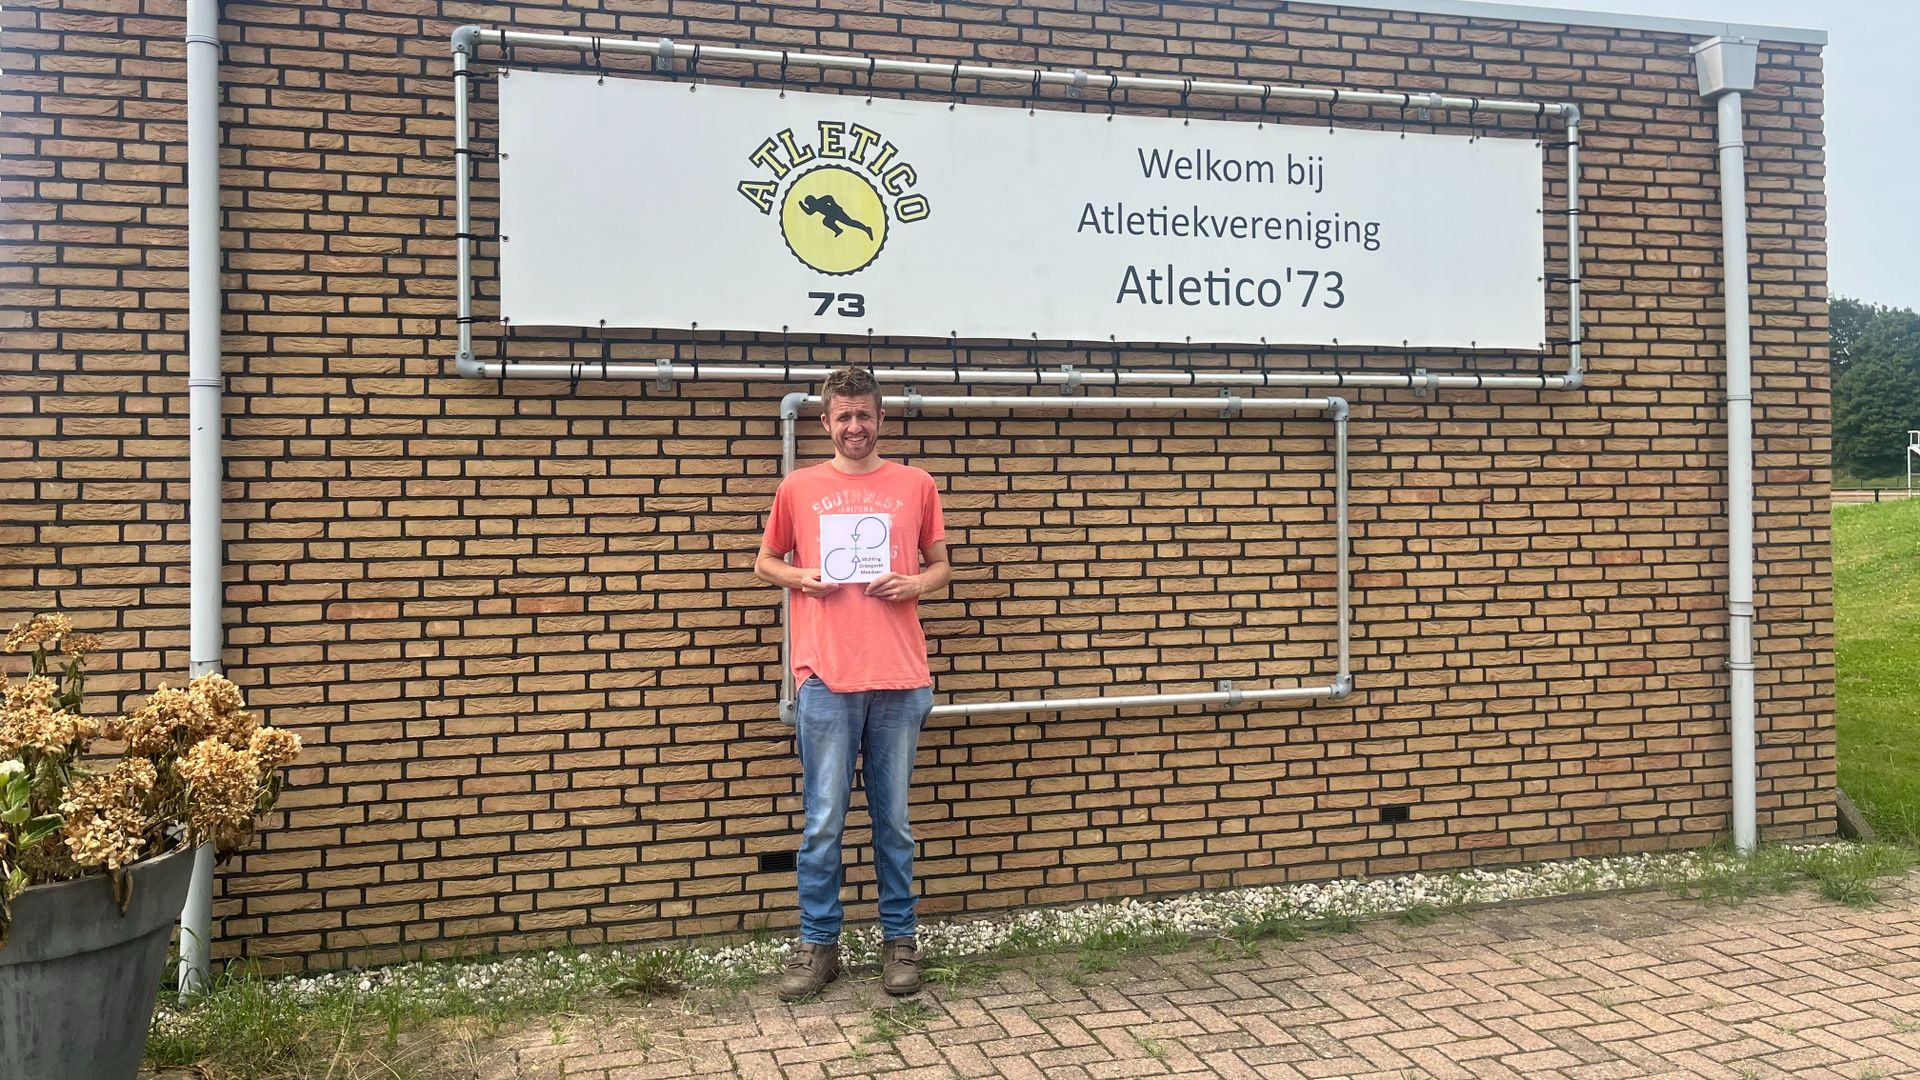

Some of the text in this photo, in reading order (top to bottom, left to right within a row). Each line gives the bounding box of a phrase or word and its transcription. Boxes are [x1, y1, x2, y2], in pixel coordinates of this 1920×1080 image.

[737, 120, 931, 224] ATLETICO
[1137, 147, 1324, 194] Welkom bij
[1077, 202, 1381, 251] Atletiekvereniging
[808, 292, 865, 318] 73
[1116, 264, 1345, 309] Atletico'73
